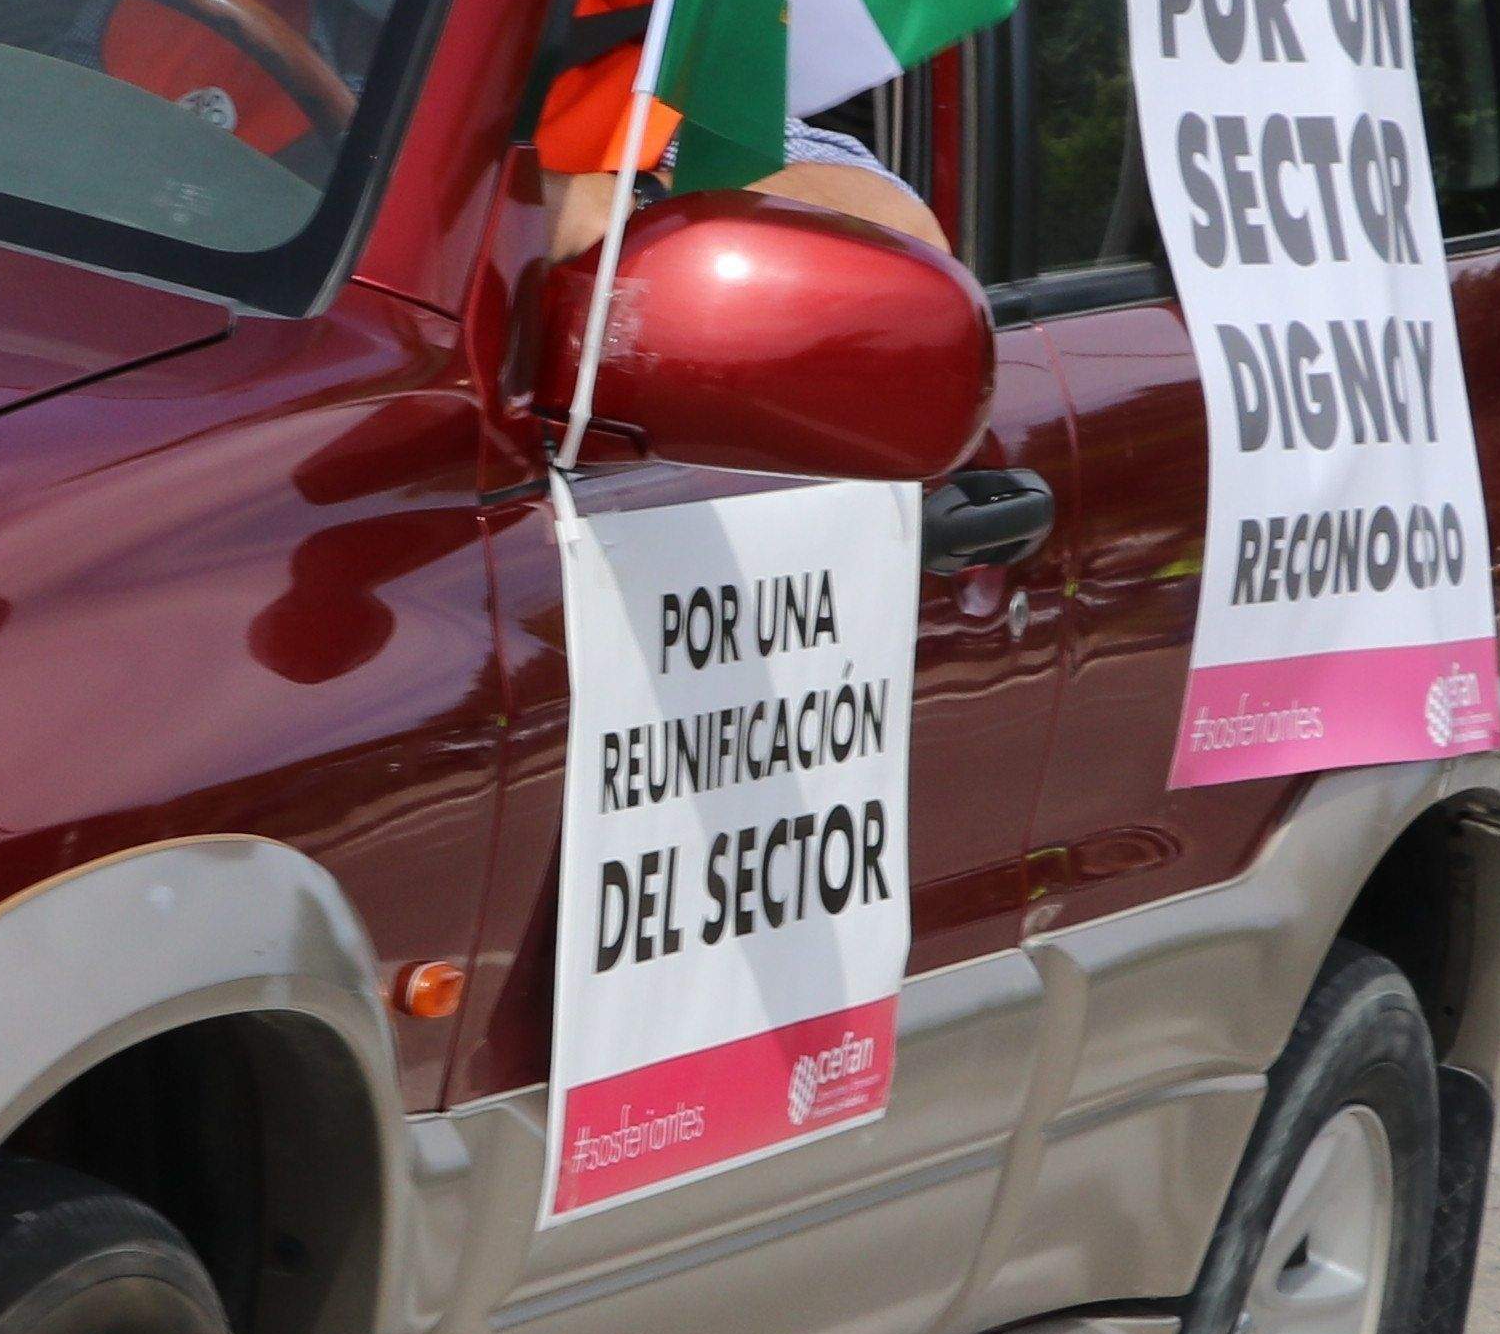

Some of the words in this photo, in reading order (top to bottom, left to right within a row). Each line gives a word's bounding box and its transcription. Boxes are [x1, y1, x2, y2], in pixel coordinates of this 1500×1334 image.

[1175, 111, 1422, 269] SECTOR
[1403, 319, 1440, 444] Y
[661, 583, 740, 675] POR
[755, 568, 840, 658] UNA
[599, 666, 890, 816] REUNIFICACIÓN
[595, 850, 684, 975] DEL
[701, 797, 893, 947] SECTOR
[814, 1031, 875, 1085] cefan
